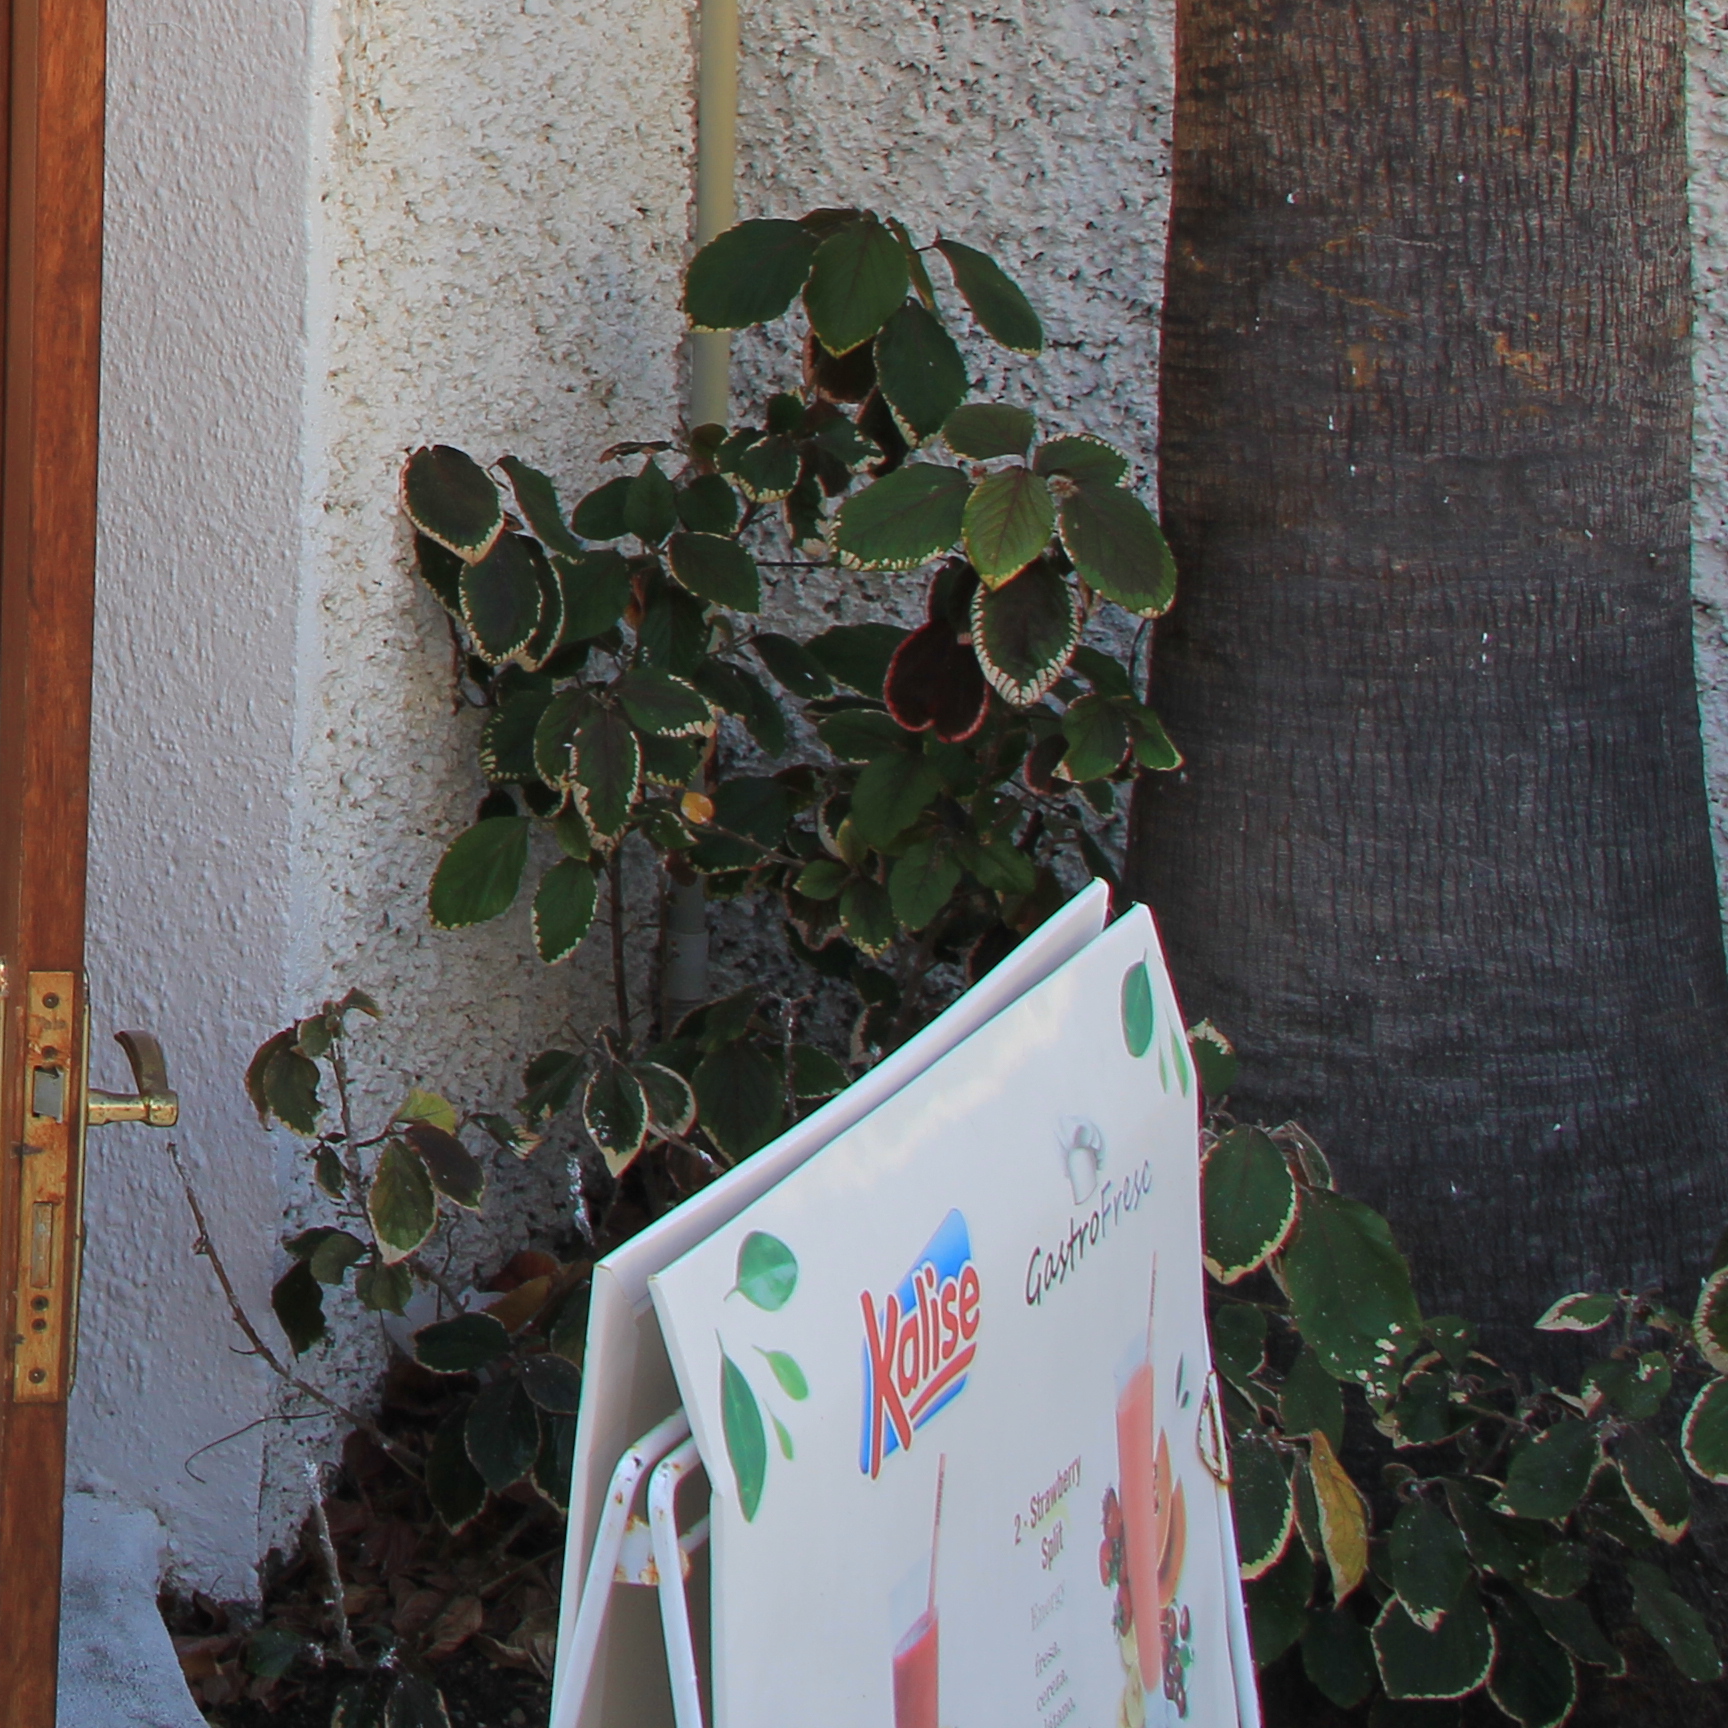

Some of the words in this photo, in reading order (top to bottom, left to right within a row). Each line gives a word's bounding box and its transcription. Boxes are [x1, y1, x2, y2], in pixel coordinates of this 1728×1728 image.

[858, 1263, 981, 1481] Kalise
[1014, 1513, 1022, 1546] 2
[1030, 1454, 1082, 1529] Strawberry
[1041, 1519, 1064, 1572] Split
